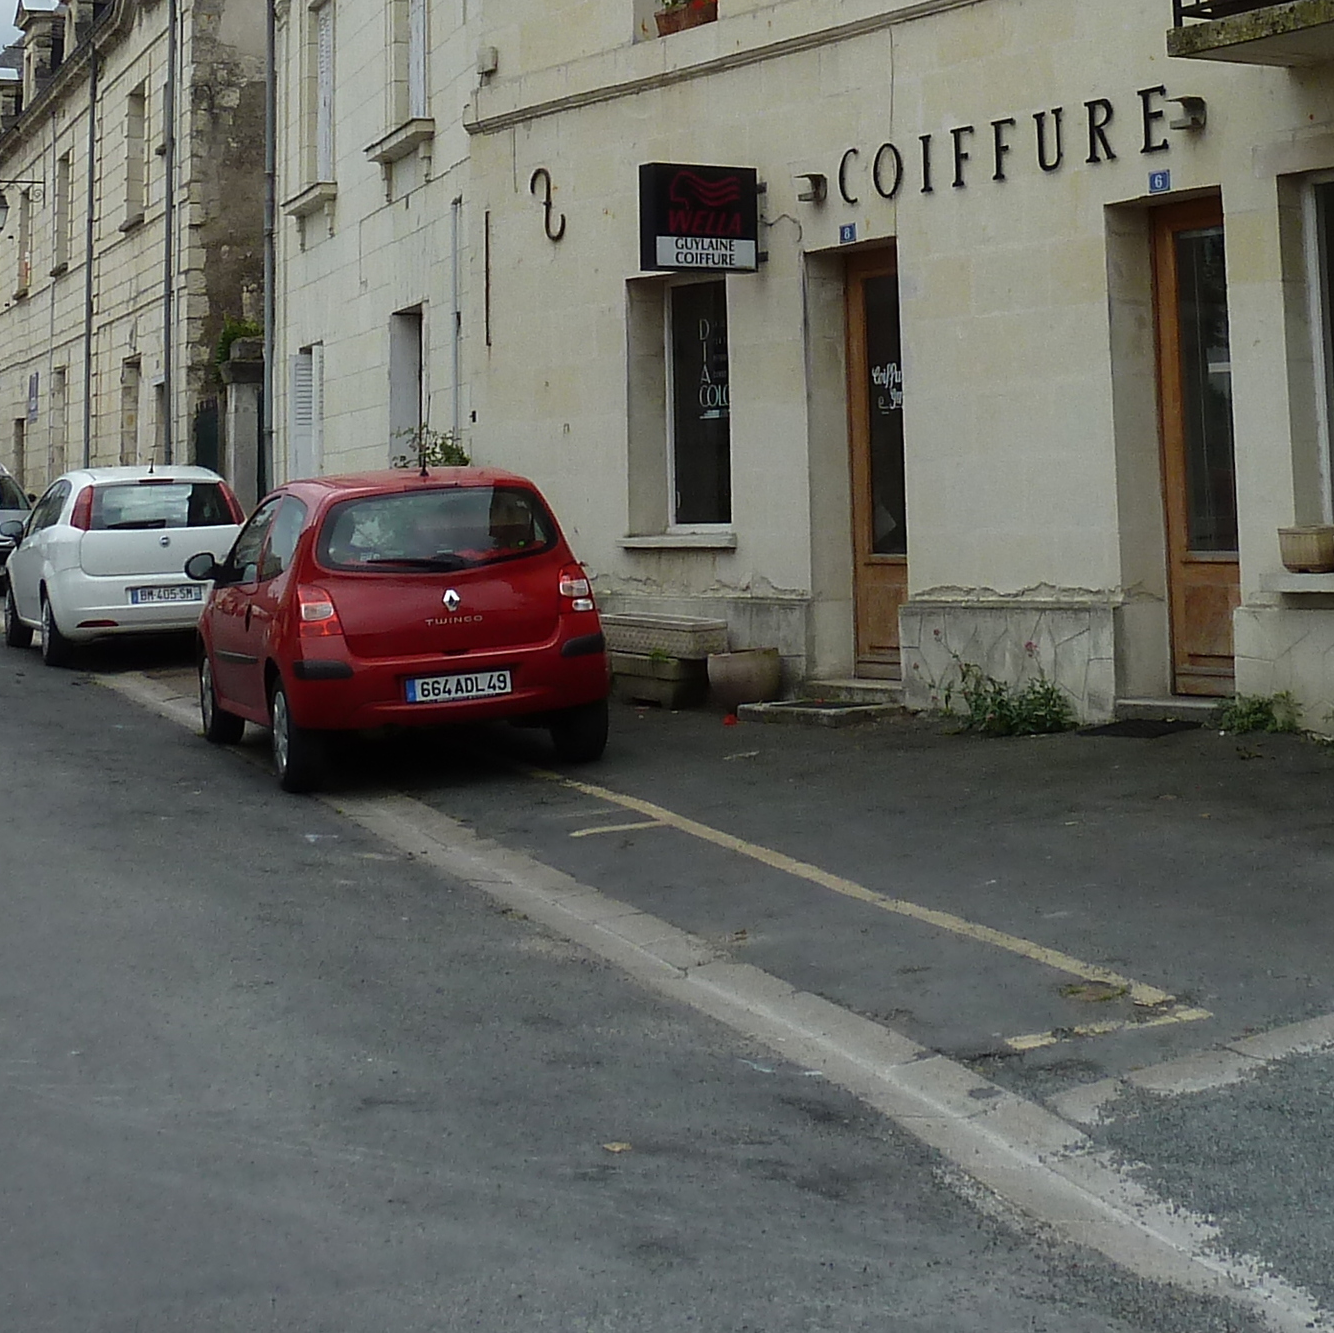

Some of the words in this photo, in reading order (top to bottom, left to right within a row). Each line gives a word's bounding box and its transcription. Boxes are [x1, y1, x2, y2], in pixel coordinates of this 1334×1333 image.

[838, 84, 1170, 204] COIFFURE
[1155, 174, 1163, 188] 6
[668, 209, 742, 235] WELLA
[844, 227, 851, 240] 8
[675, 237, 735, 252] GUYLAINE
[675, 251, 735, 266] COIFFURE
[425, 615, 483, 626] TWINGO
